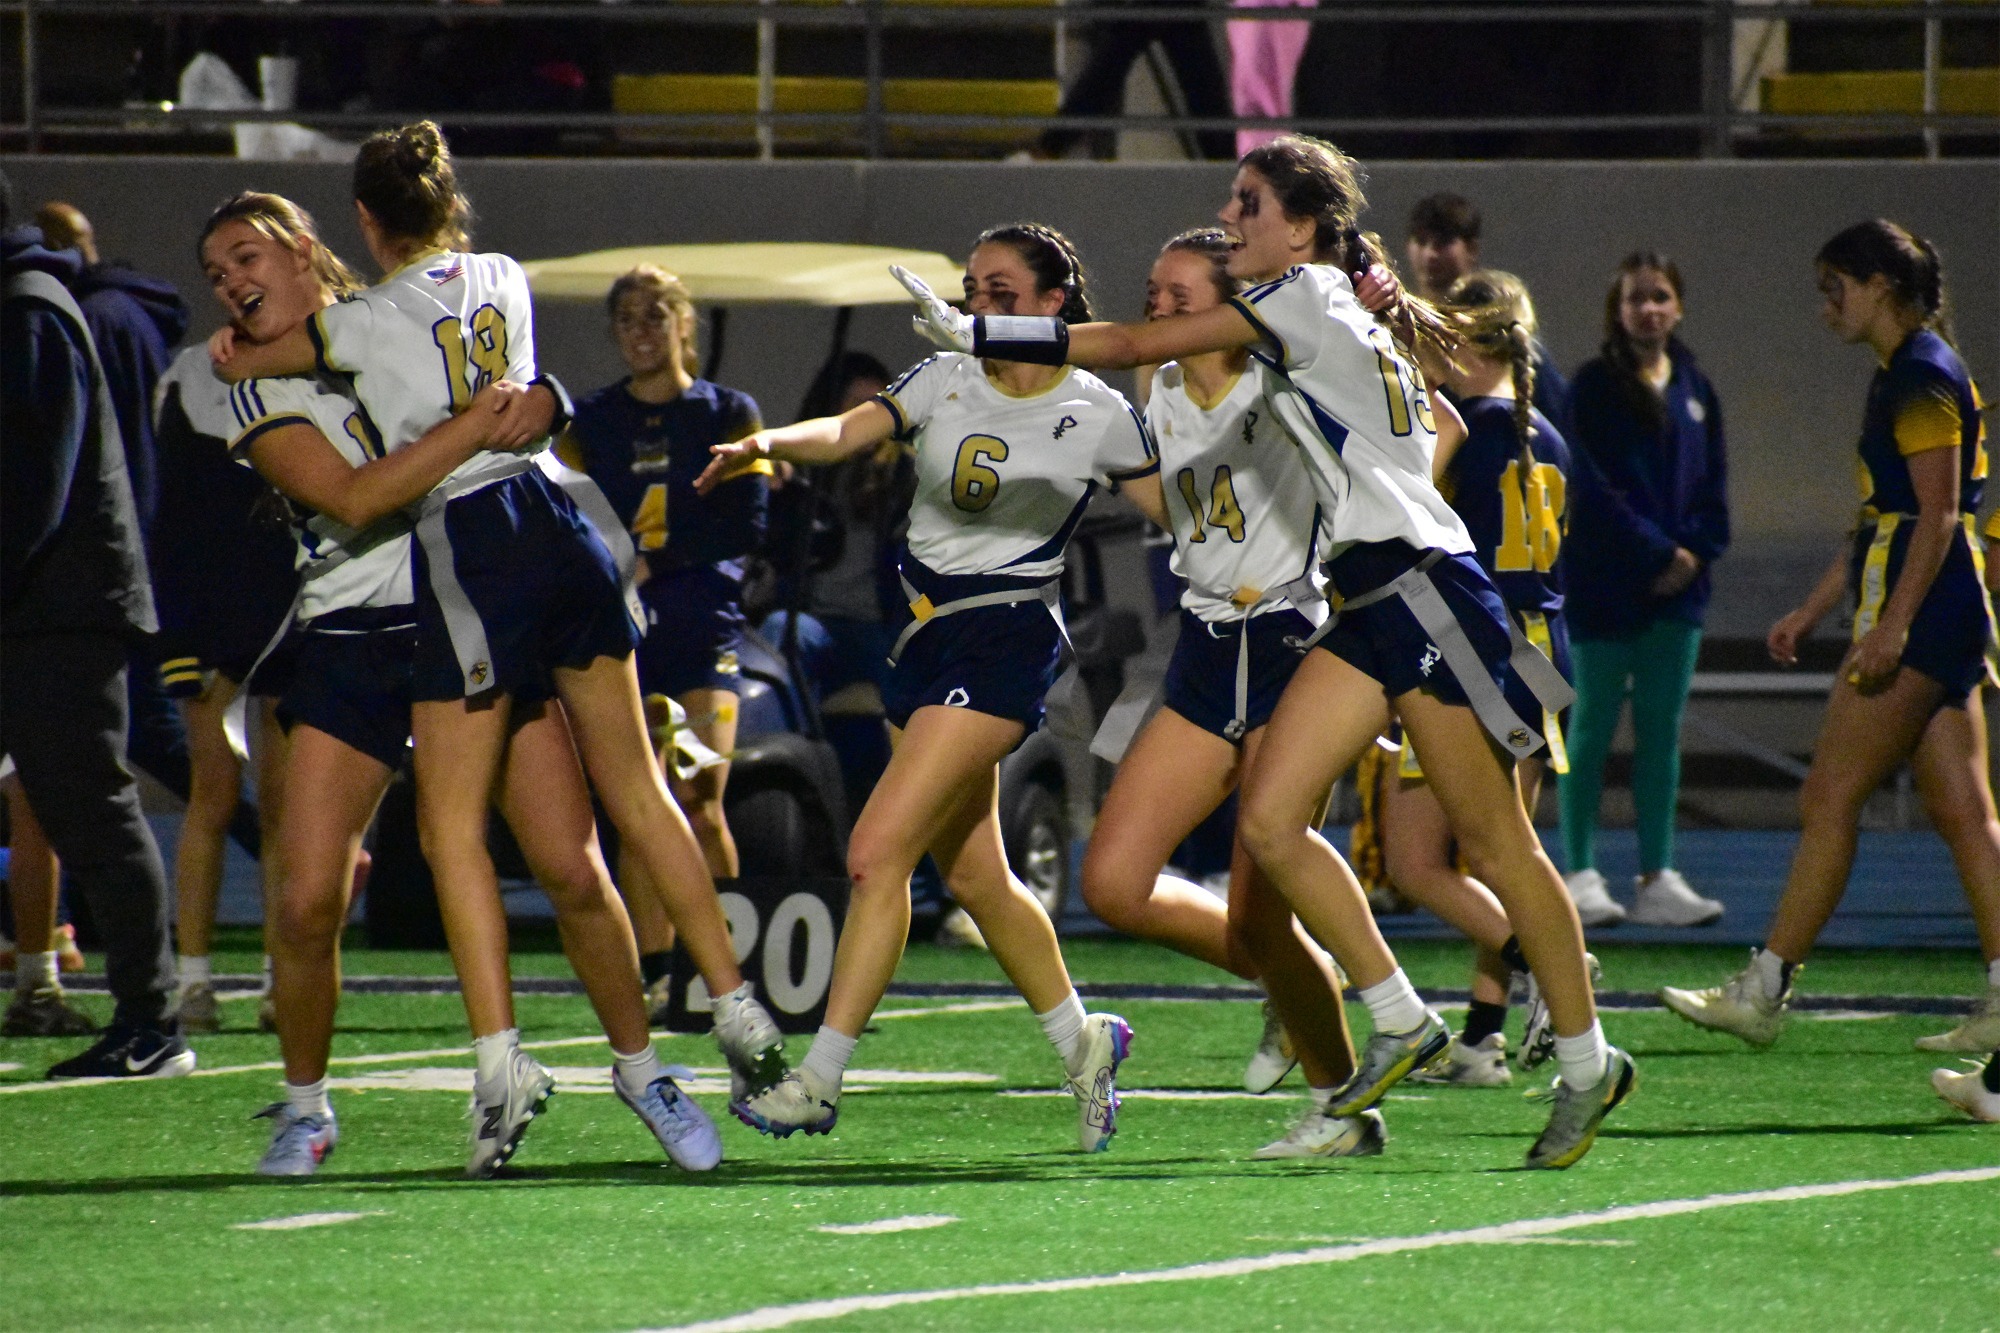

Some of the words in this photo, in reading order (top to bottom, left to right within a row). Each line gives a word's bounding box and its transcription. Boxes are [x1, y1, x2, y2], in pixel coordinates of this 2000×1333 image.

[951, 433, 1009, 513] 6
[1177, 465, 1246, 543] 14
[631, 483, 669, 551] 4
[1495, 459, 1567, 573] 18
